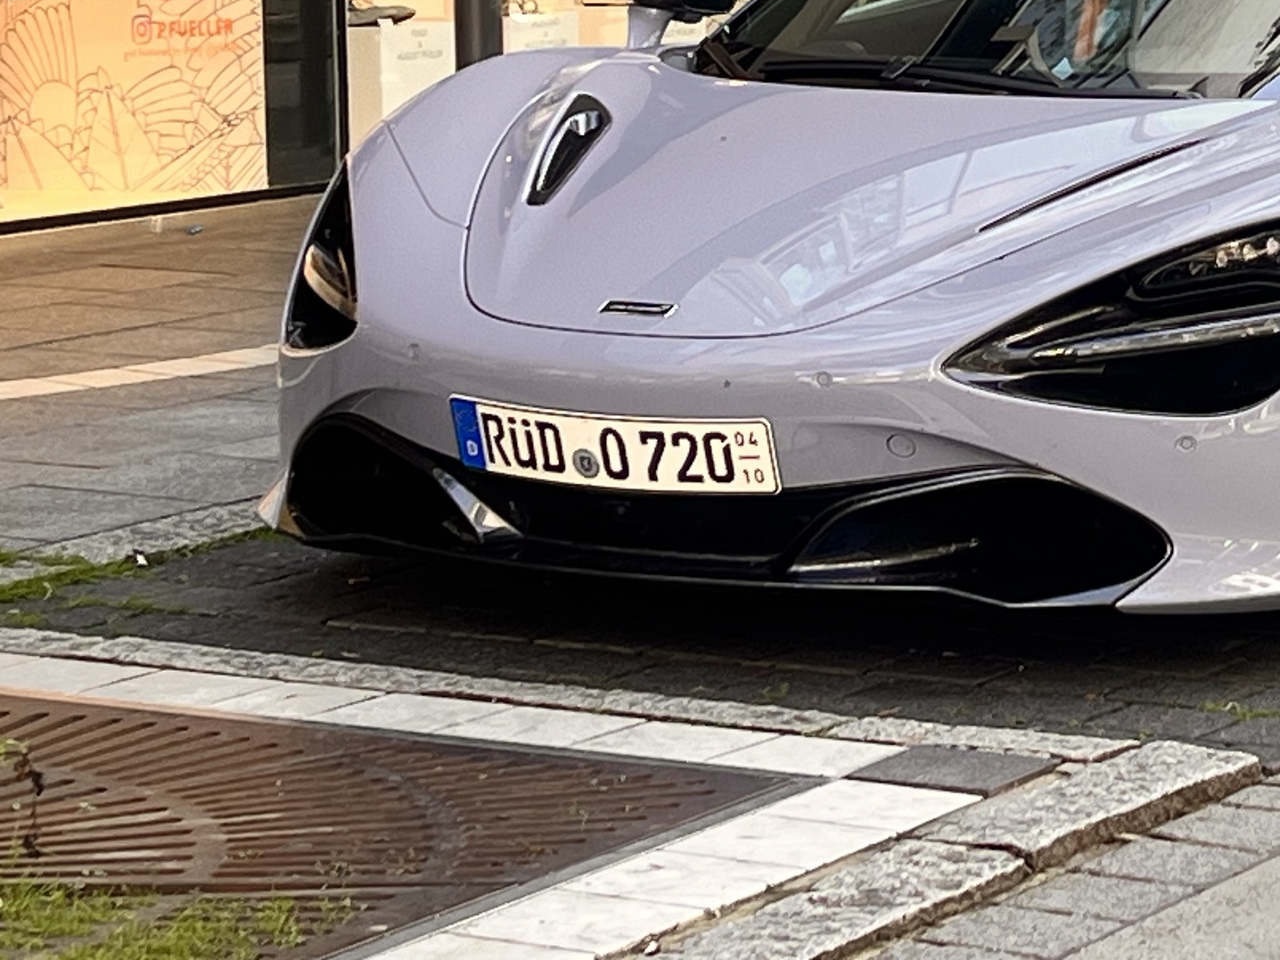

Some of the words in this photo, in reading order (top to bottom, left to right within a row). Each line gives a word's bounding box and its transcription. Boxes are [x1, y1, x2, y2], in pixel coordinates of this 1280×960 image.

[480, 412, 566, 473] RÜD
[639, 430, 735, 483] 720
[734, 431, 758, 447] 04
[742, 468, 765, 484] 10
